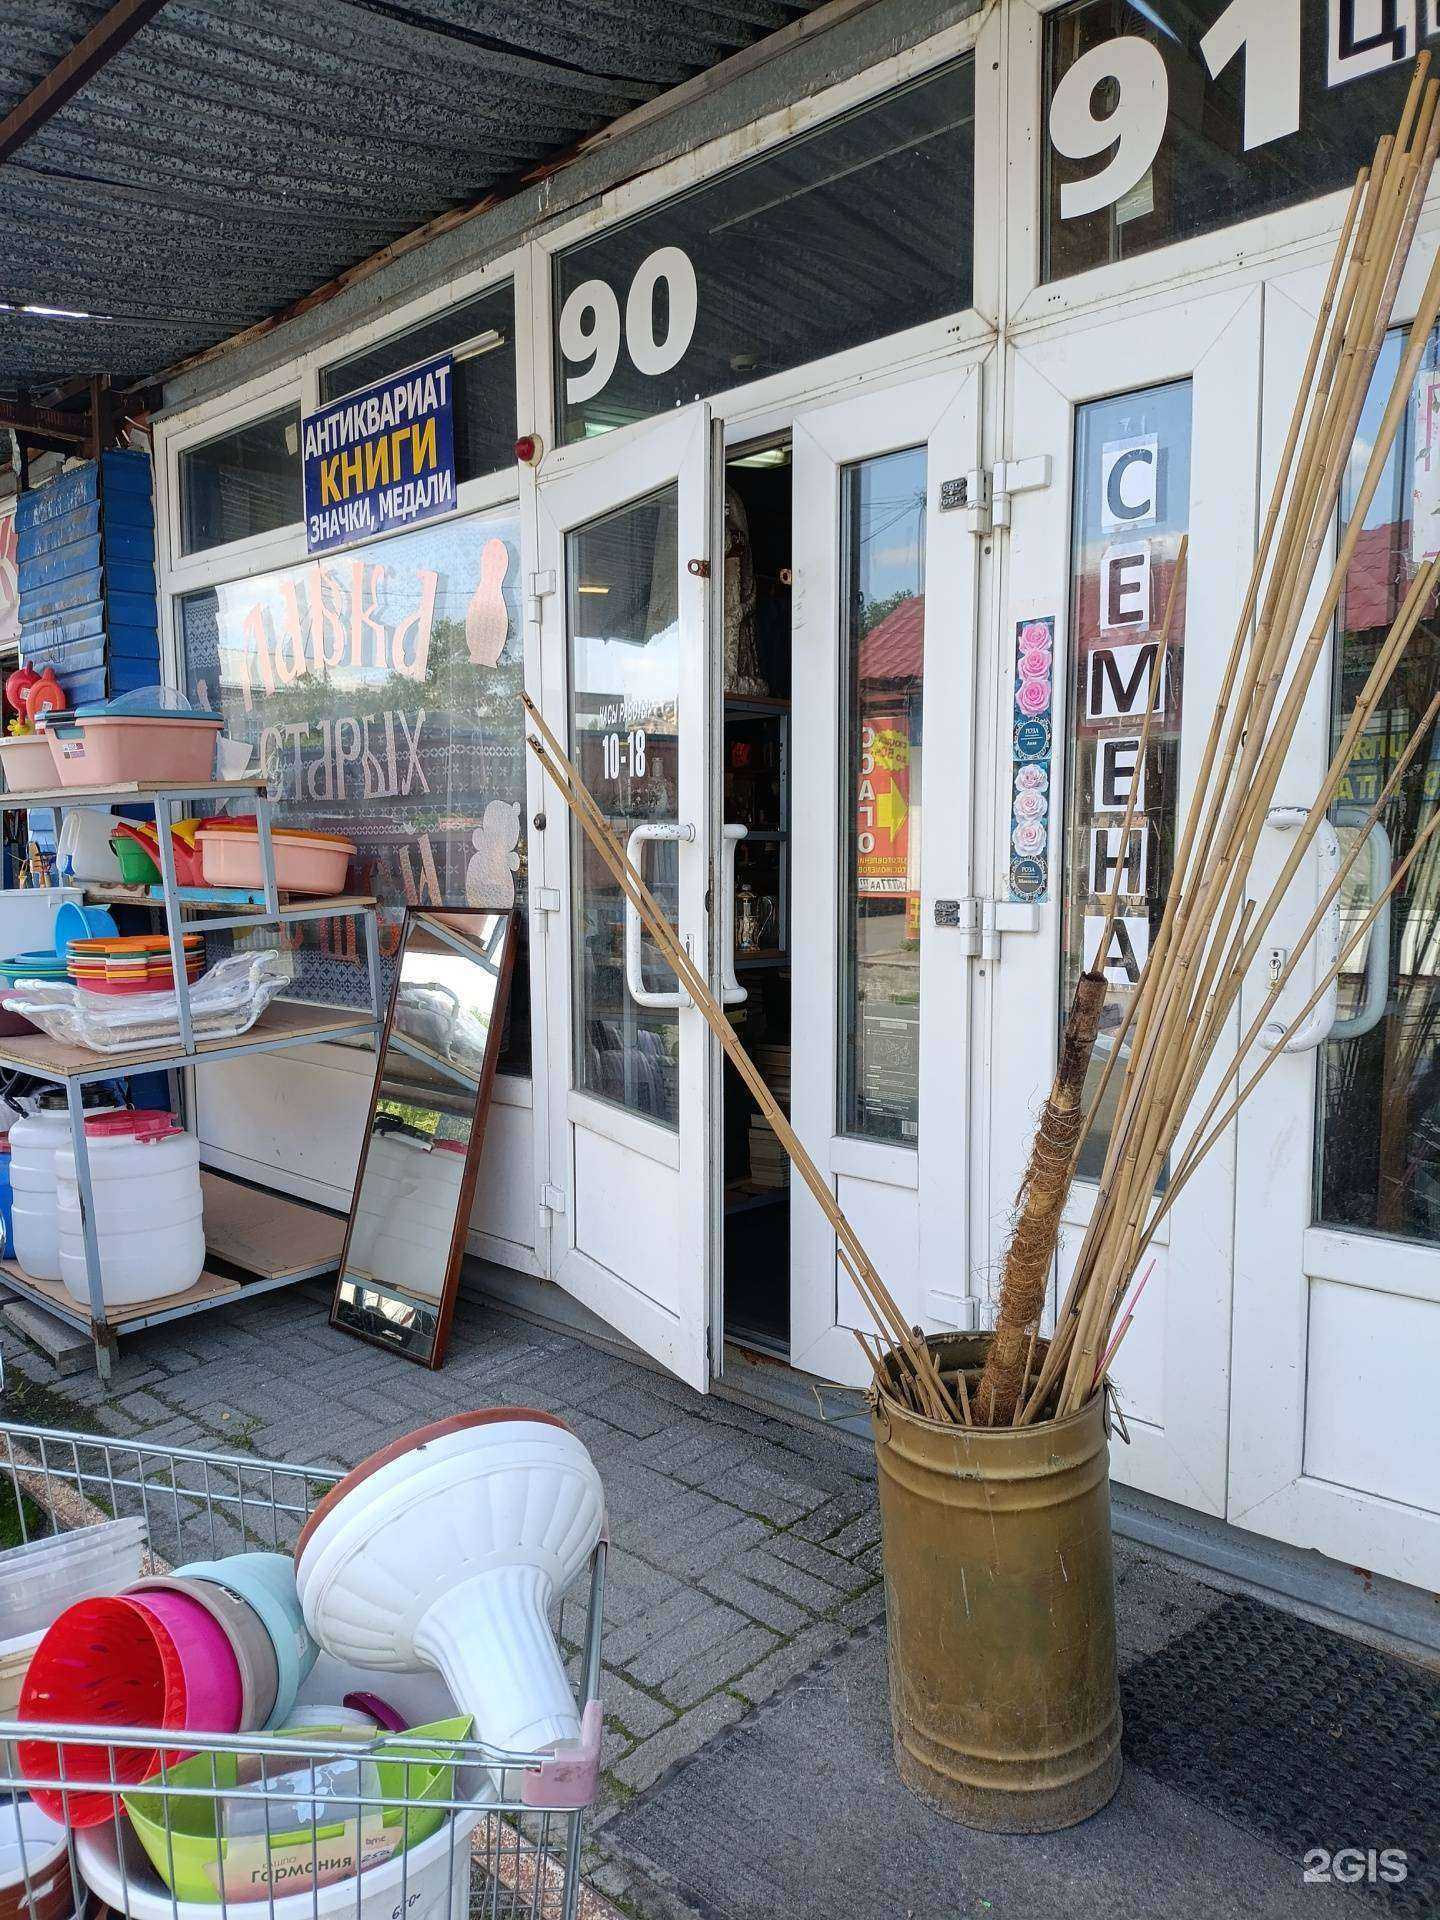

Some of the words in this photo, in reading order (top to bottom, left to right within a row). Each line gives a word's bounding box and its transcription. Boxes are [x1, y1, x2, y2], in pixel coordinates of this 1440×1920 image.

[1050, 0, 1300, 219] 91
[559, 246, 698, 404] 90
[304, 365, 450, 461] АНТИКВАРИАТ
[310, 495, 377, 543] ЗНАЧКИ,
[379, 469, 452, 522] МЕДАЛИ
[321, 417, 437, 506] КНИГИ
[602, 729, 646, 779] 10-18
[1090, 448, 1160, 985] СЕМЕНА
[251, 1856, 352, 1884] гармония
[261, 1855, 297, 1869] кшпо
